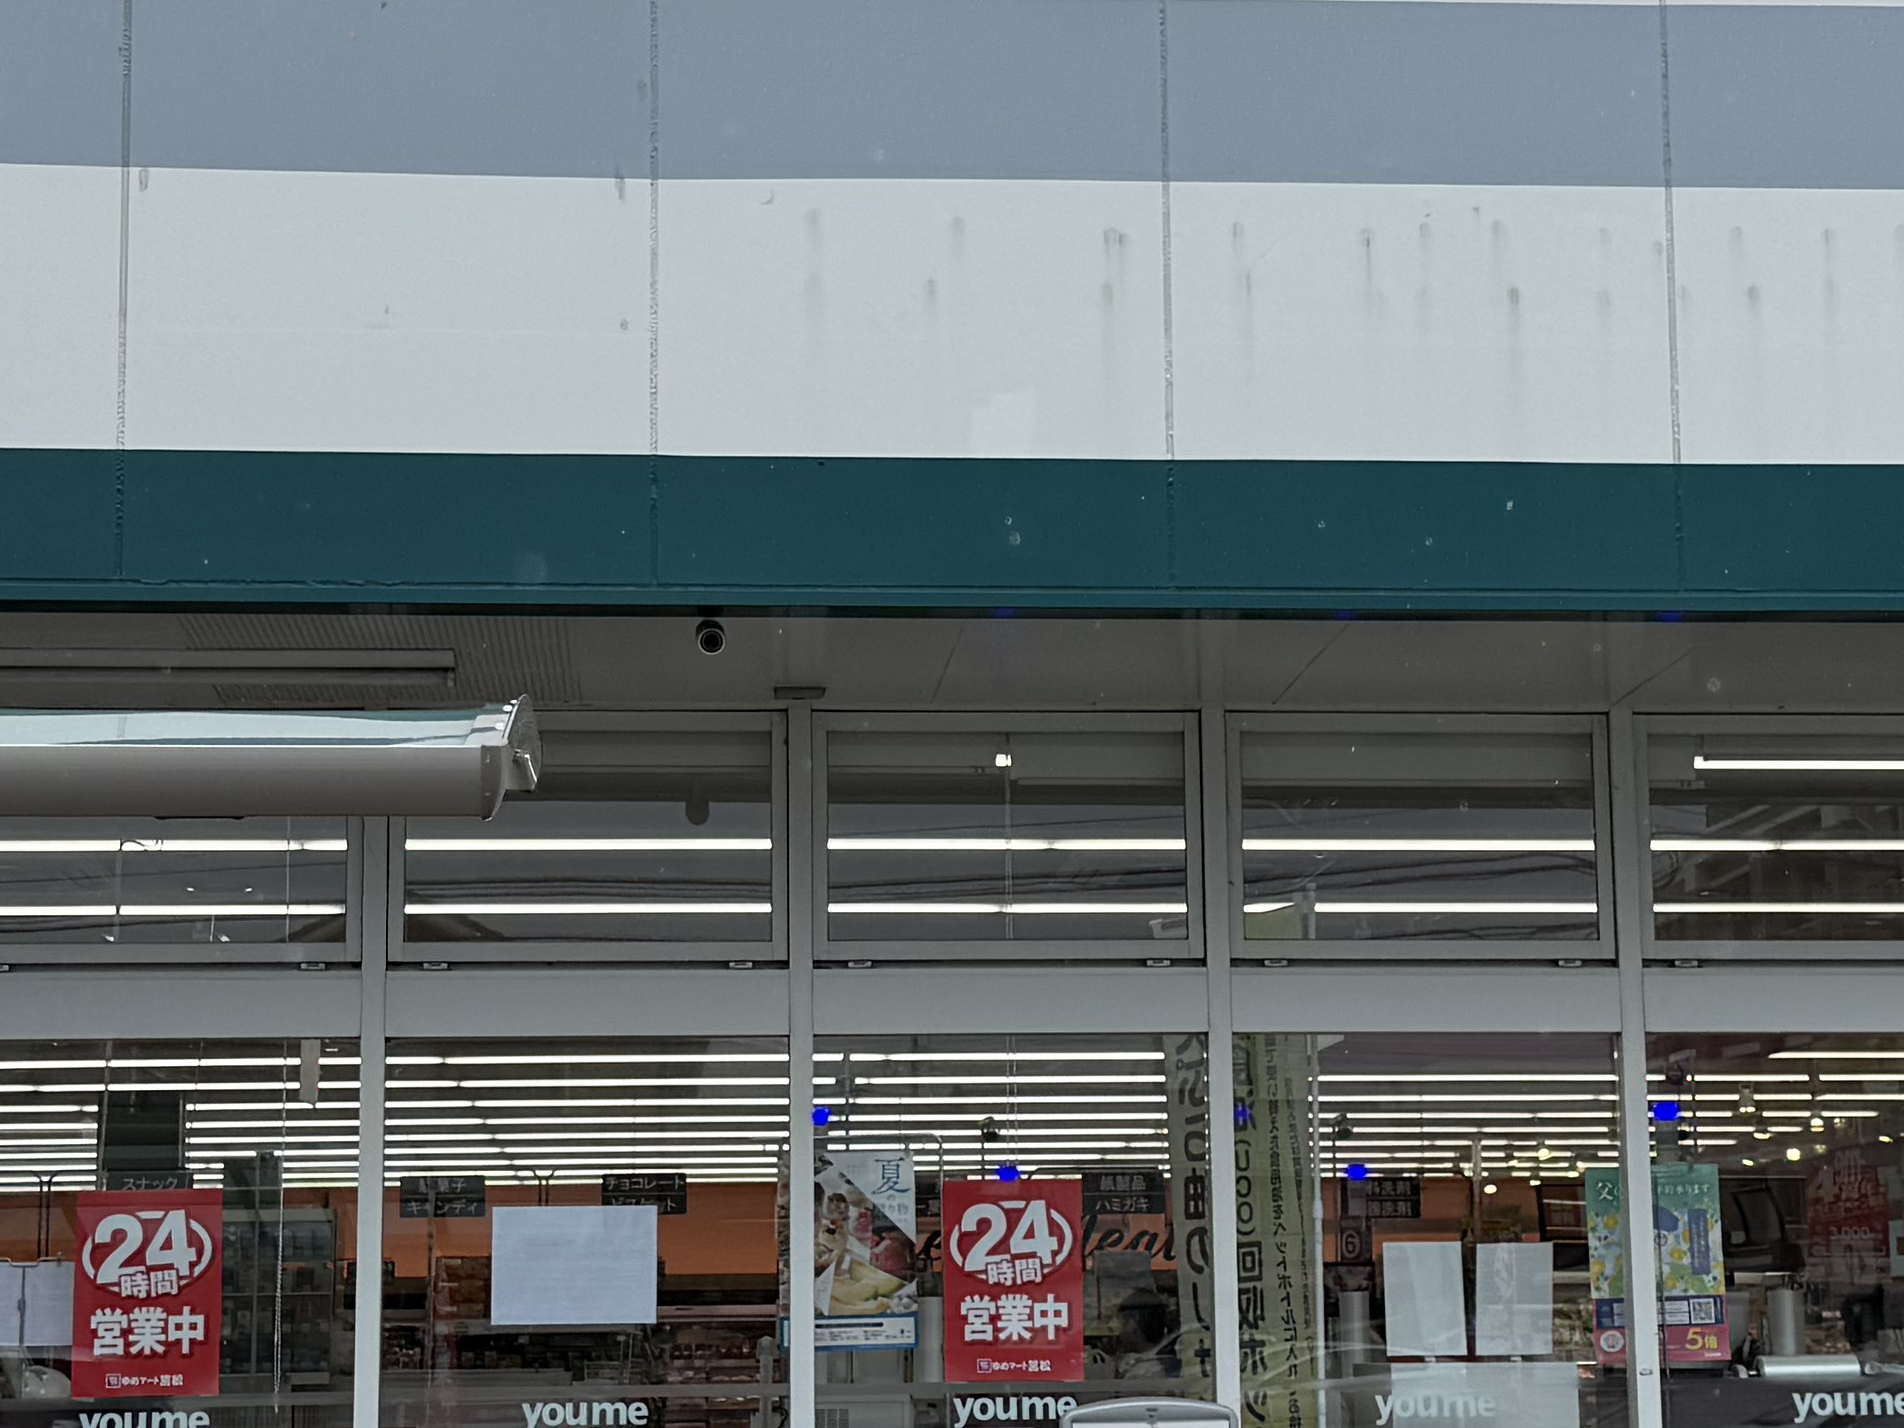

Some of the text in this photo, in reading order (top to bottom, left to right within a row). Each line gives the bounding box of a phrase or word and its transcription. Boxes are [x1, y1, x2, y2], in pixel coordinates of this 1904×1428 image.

[122, 1177, 179, 1190] スナック
[605, 1174, 685, 1190] チョコレート
[872, 1156, 912, 1195] 夏
[406, 1200, 478, 1213] キンディ
[1095, 1194, 1150, 1212] ハミガキ
[93, 1209, 197, 1285] 24
[960, 1199, 1059, 1272] 24
[119, 1269, 180, 1299] 時間
[986, 1257, 1043, 1286] 時間
[89, 1305, 206, 1356] 営業中
[960, 1293, 1069, 1342] 営業中
[1374, 1391, 1497, 1425] youme
